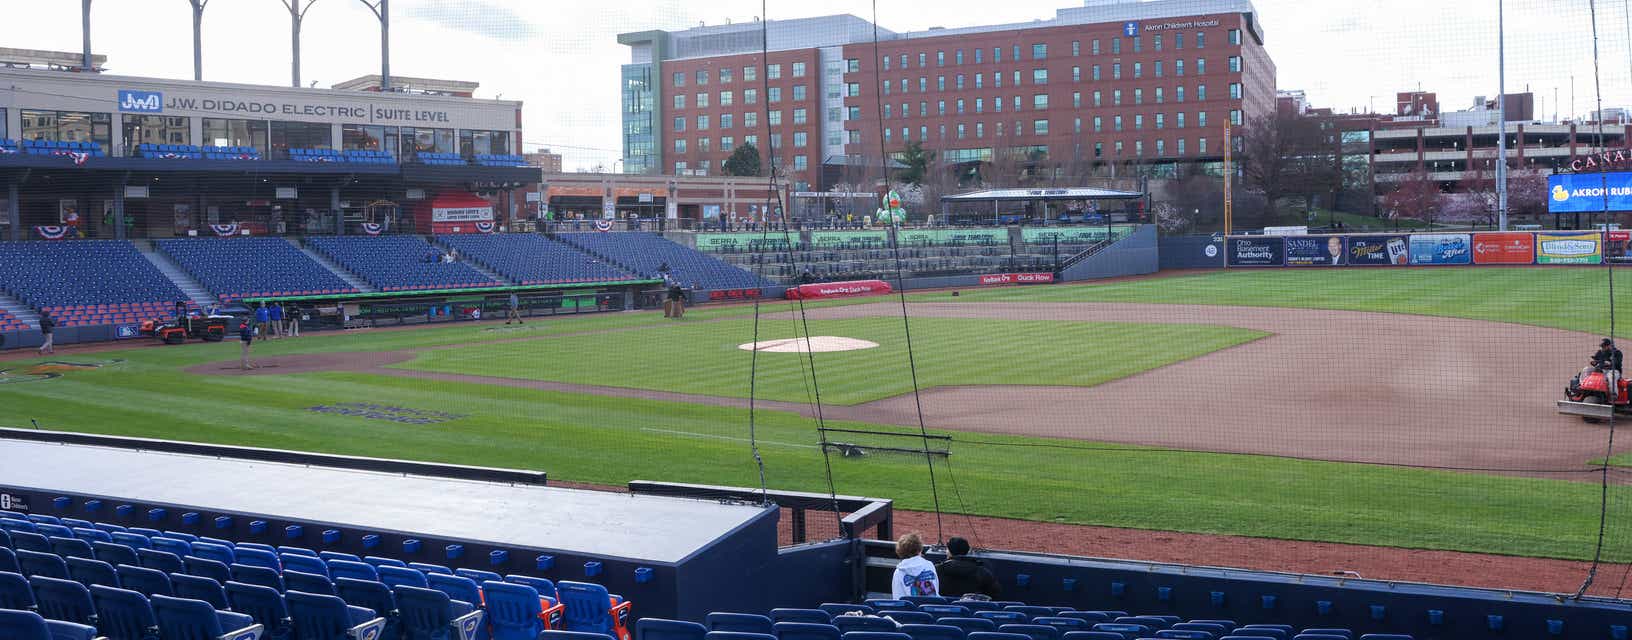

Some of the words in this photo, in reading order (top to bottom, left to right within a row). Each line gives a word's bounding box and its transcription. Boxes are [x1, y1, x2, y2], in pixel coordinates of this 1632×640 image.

[1193, 20, 1219, 28] Hospital
[166, 98, 198, 110] J.W.
[202, 99, 276, 114] DIDADO
[282, 104, 365, 118] ELECTRIC
[376, 108, 410, 121] SUITE
[415, 110, 449, 122] LEVEL
[1571, 150, 1632, 171] CANA
[1572, 188, 1609, 197] AKRON
[1611, 187, 1632, 196] RUB
[710, 237, 738, 246] SERRA
[1237, 252, 1272, 260] Authority
